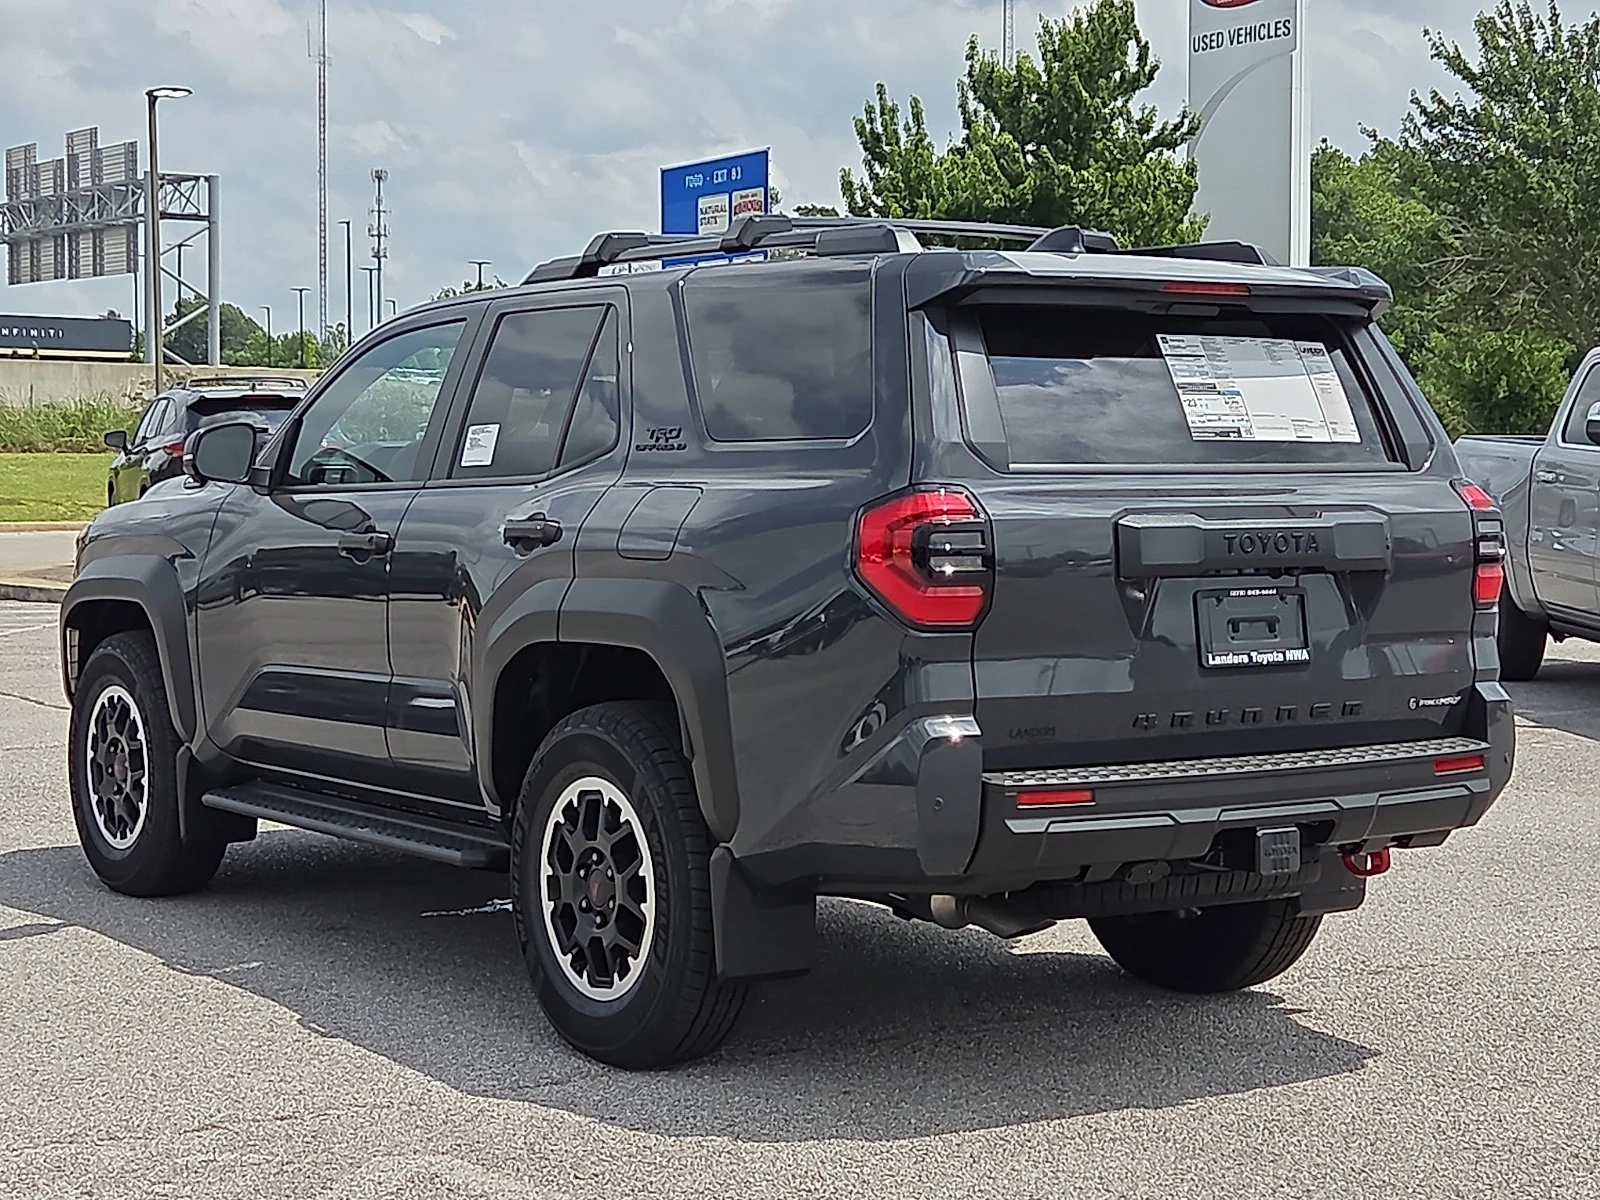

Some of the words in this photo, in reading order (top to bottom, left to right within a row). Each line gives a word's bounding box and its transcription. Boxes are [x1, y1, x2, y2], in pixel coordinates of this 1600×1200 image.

[1193, 31, 1224, 53] USED
[1228, 19, 1291, 46] VEHICLES
[713, 169, 727, 184] EXIT
[699, 203, 727, 216] NATURAL
[1223, 531, 1320, 555] TOYOTA
[1208, 652, 1250, 665] Landers
[1250, 650, 1284, 665] Toyota
[1285, 648, 1310, 662] NWA
[1131, 700, 1363, 730] 4RUNNER
[1008, 725, 1057, 740] LANDERS
[650, 831, 671, 962] MICHELIN
